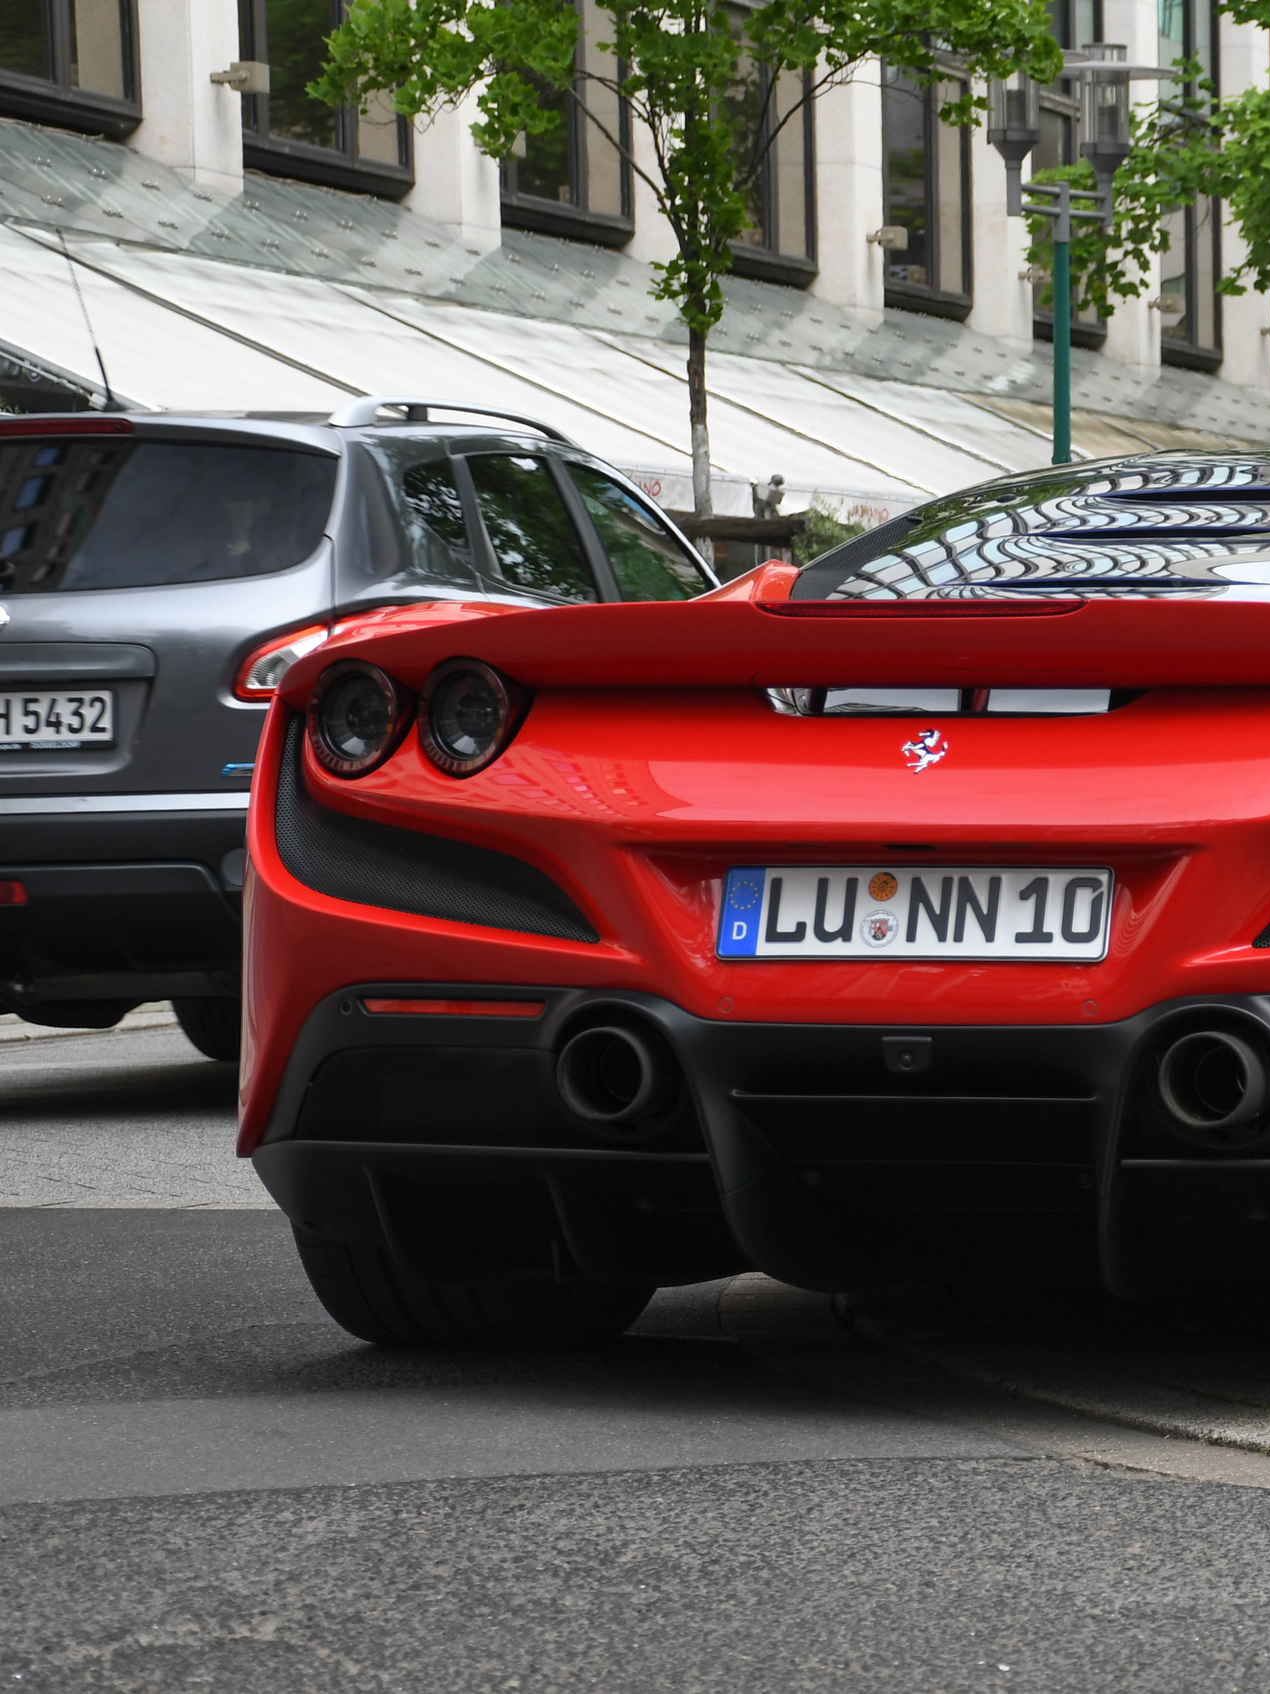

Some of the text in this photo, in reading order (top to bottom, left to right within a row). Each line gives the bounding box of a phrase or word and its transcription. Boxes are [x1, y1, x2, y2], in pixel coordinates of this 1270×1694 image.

[22, 697, 107, 735] 5432
[765, 876, 1104, 943] LU NN 10
[732, 921, 747, 940] D
